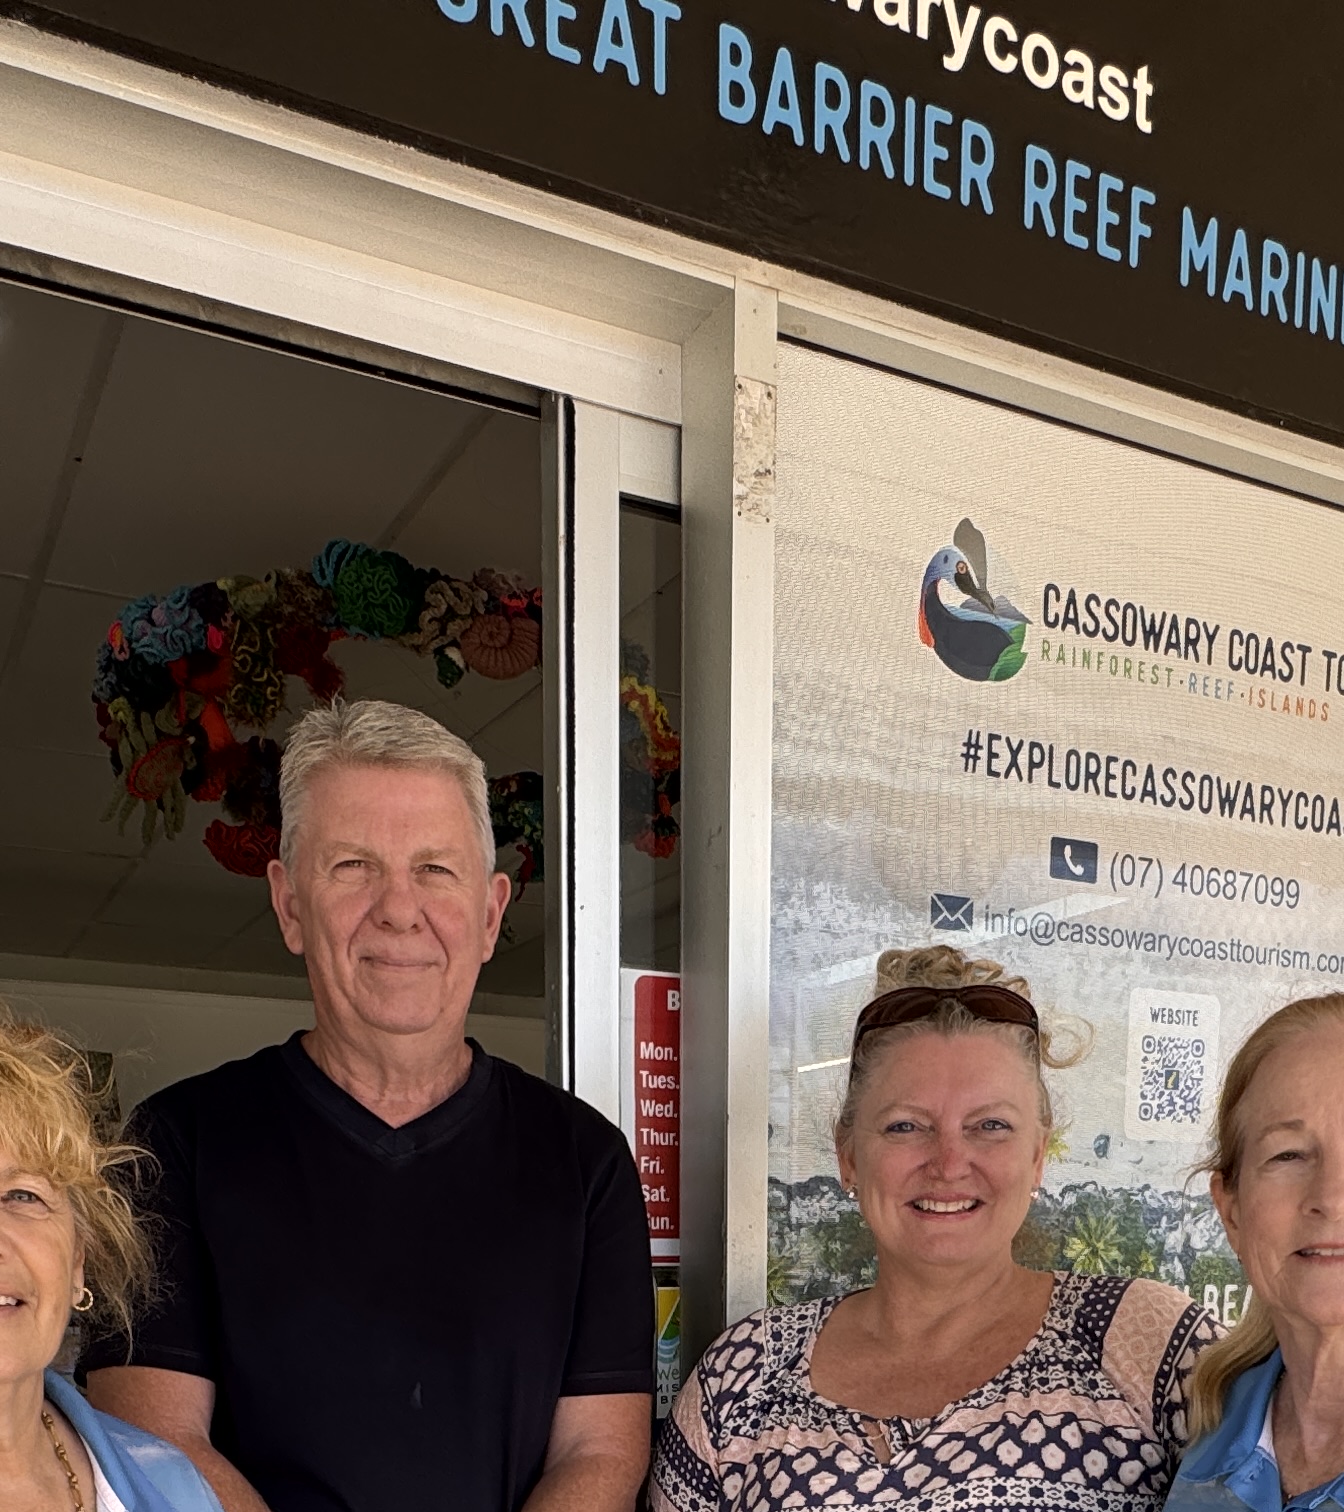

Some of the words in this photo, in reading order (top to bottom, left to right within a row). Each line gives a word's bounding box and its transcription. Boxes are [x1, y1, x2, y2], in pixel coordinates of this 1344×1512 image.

[824, 0, 1155, 134] arycoast
[717, 24, 995, 216] BARRIER
[1023, 143, 1156, 268] REEF
[1043, 583, 1220, 666] CASSOWARY
[1227, 629, 1313, 686] COAST
[1040, 638, 1175, 688] RAINFOREST
[1187, 672, 1235, 701] REEF
[1248, 685, 1331, 722] ISLANDS
[1109, 851, 1165, 898] (07)
[1172, 862, 1301, 910] 40687099
[1149, 1006, 1200, 1027] WEBSITE
[640, 1041, 678, 1061] Mon.
[640, 1070, 680, 1090] Tues.
[640, 1099, 678, 1119] Wed.
[640, 1127, 679, 1147] Thur.
[640, 1156, 665, 1175] Fri.
[641, 1184, 670, 1204] Sat.
